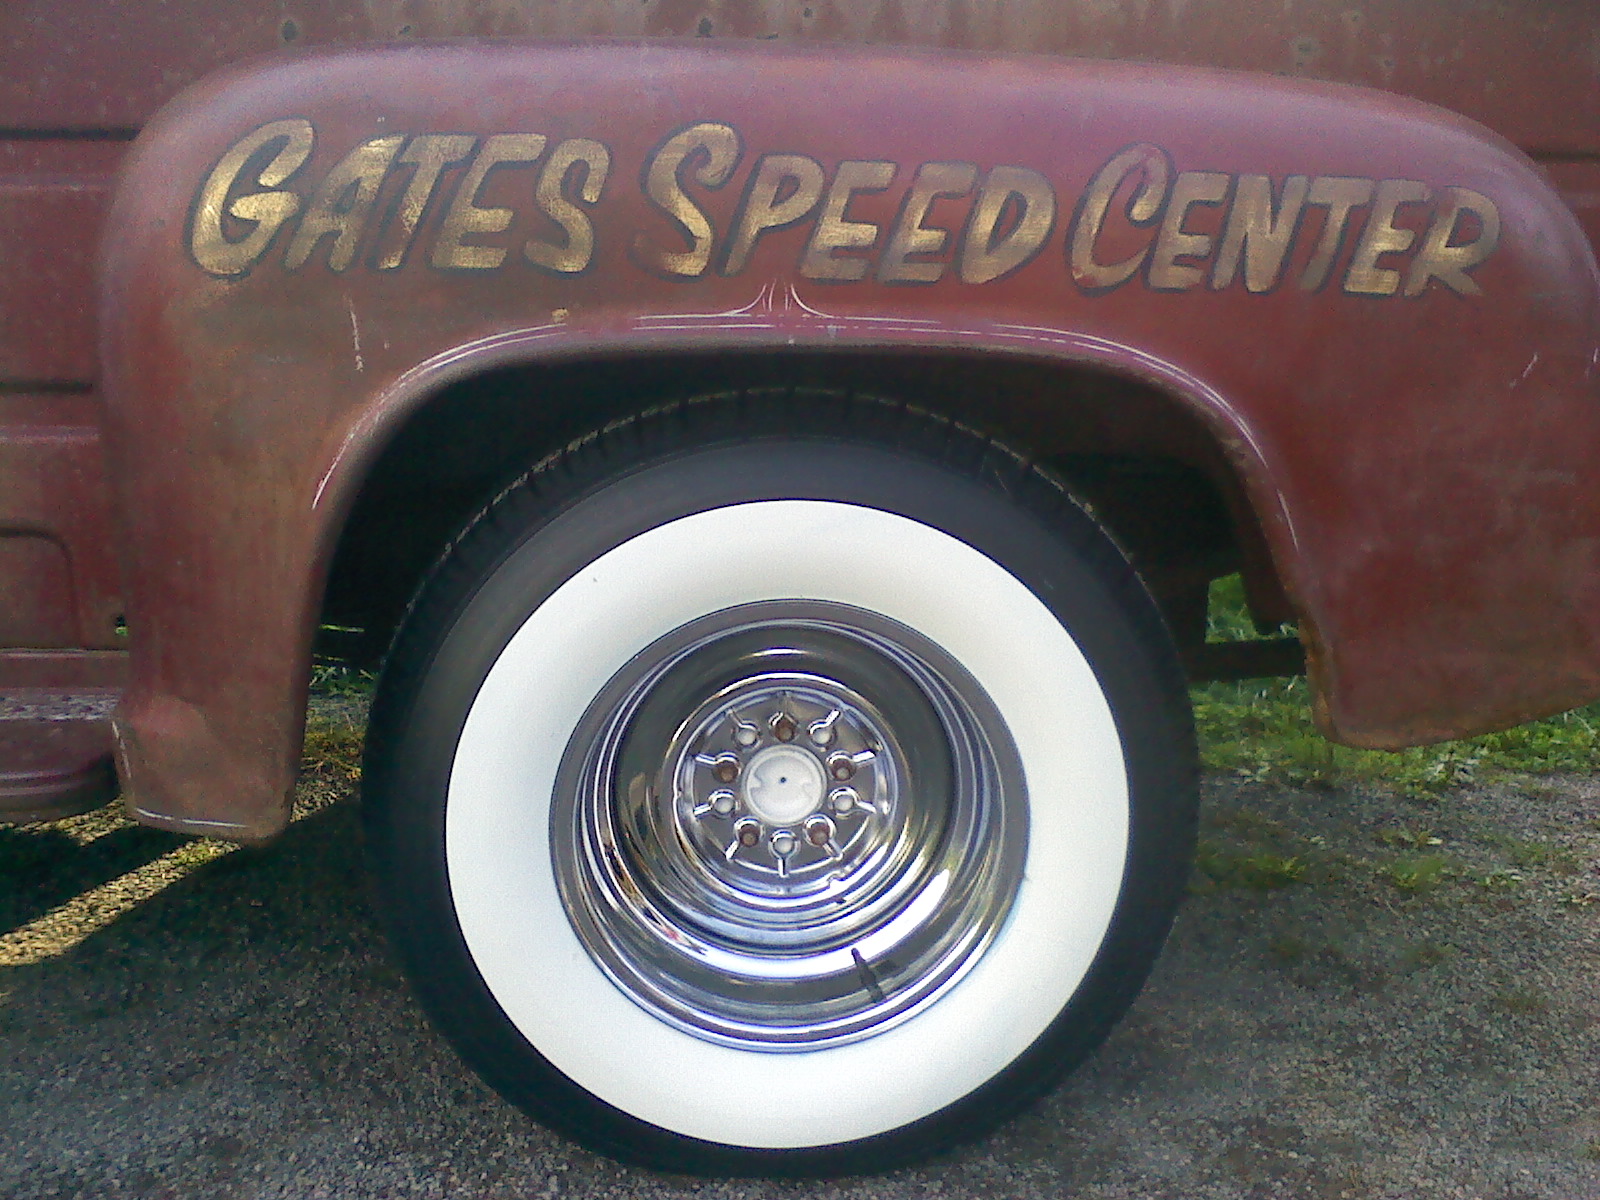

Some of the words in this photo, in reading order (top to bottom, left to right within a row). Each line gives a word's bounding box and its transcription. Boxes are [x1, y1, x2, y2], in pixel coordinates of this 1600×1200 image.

[189, 118, 611, 277] GATES
[634, 121, 1056, 286] SPEED
[1069, 142, 1502, 298] CENTER
